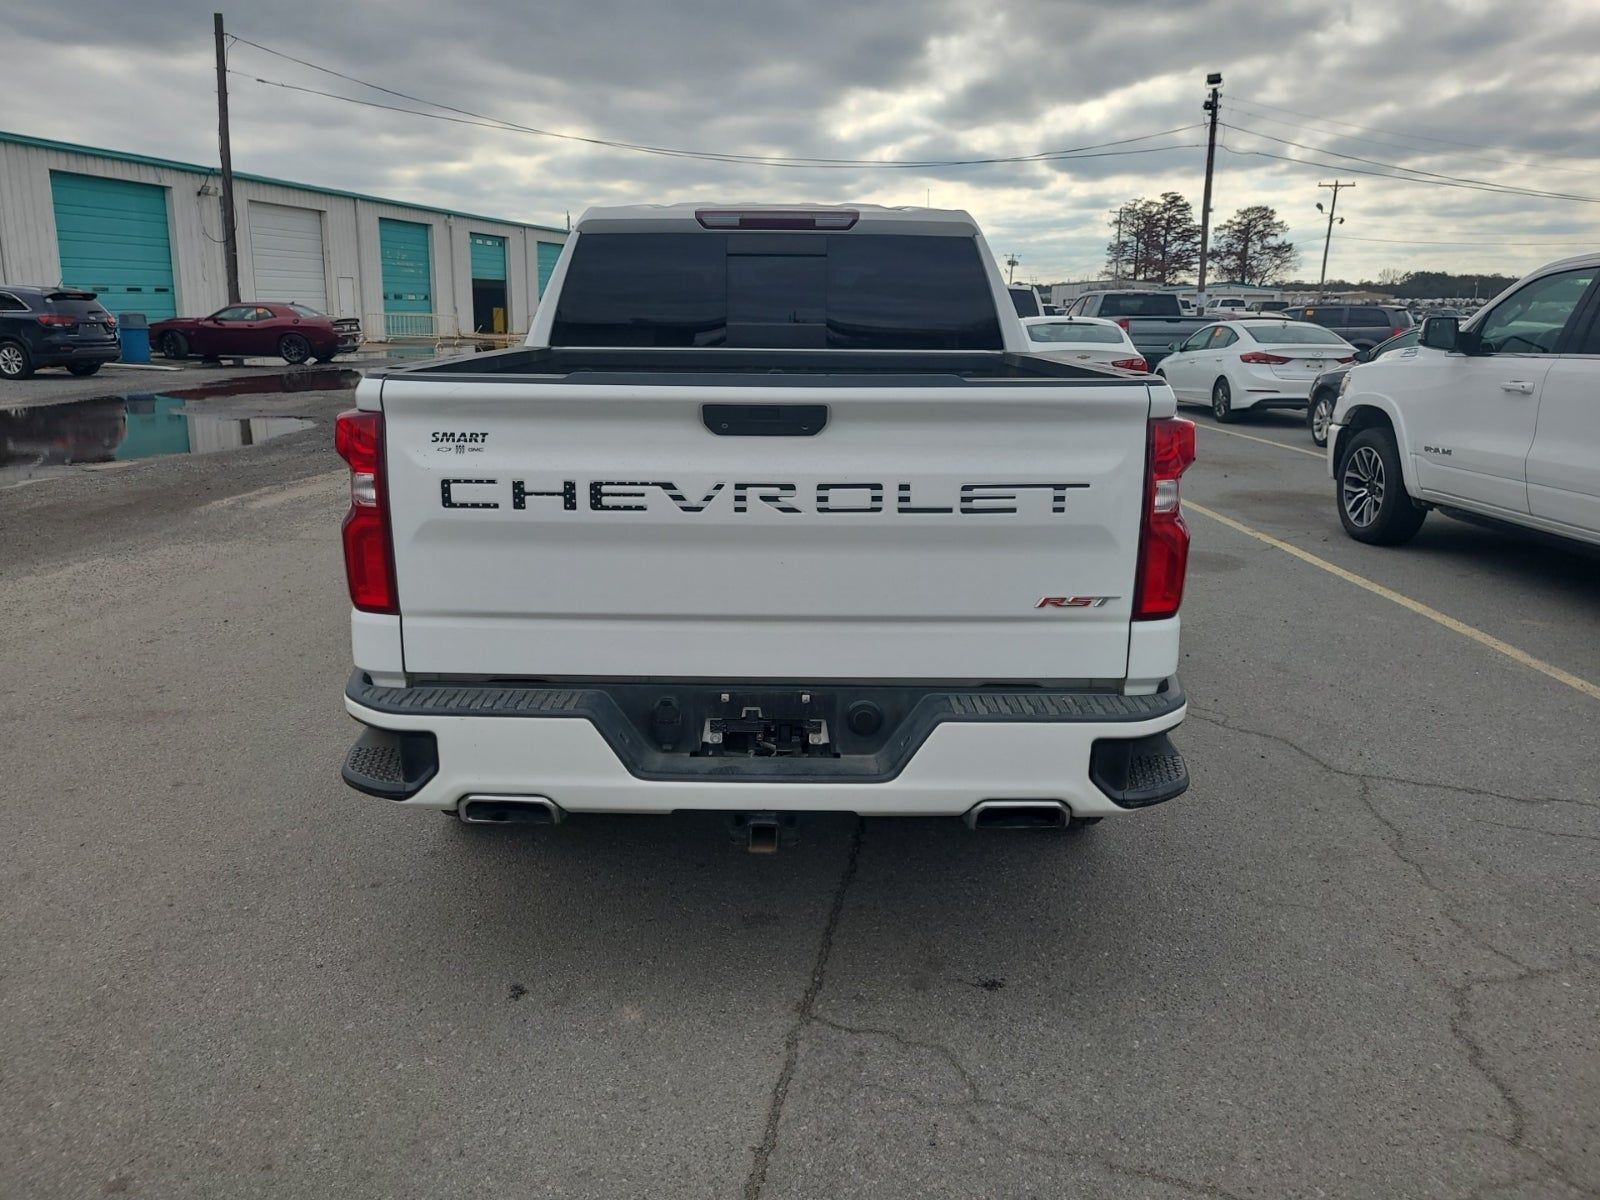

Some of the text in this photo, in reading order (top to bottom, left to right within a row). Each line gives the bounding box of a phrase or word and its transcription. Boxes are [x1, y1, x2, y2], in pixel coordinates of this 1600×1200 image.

[431, 431, 489, 443] SMART
[1424, 445, 1453, 456] RAM
[440, 478, 1090, 513] CHEVROLET
[1034, 596, 1122, 608] RST
